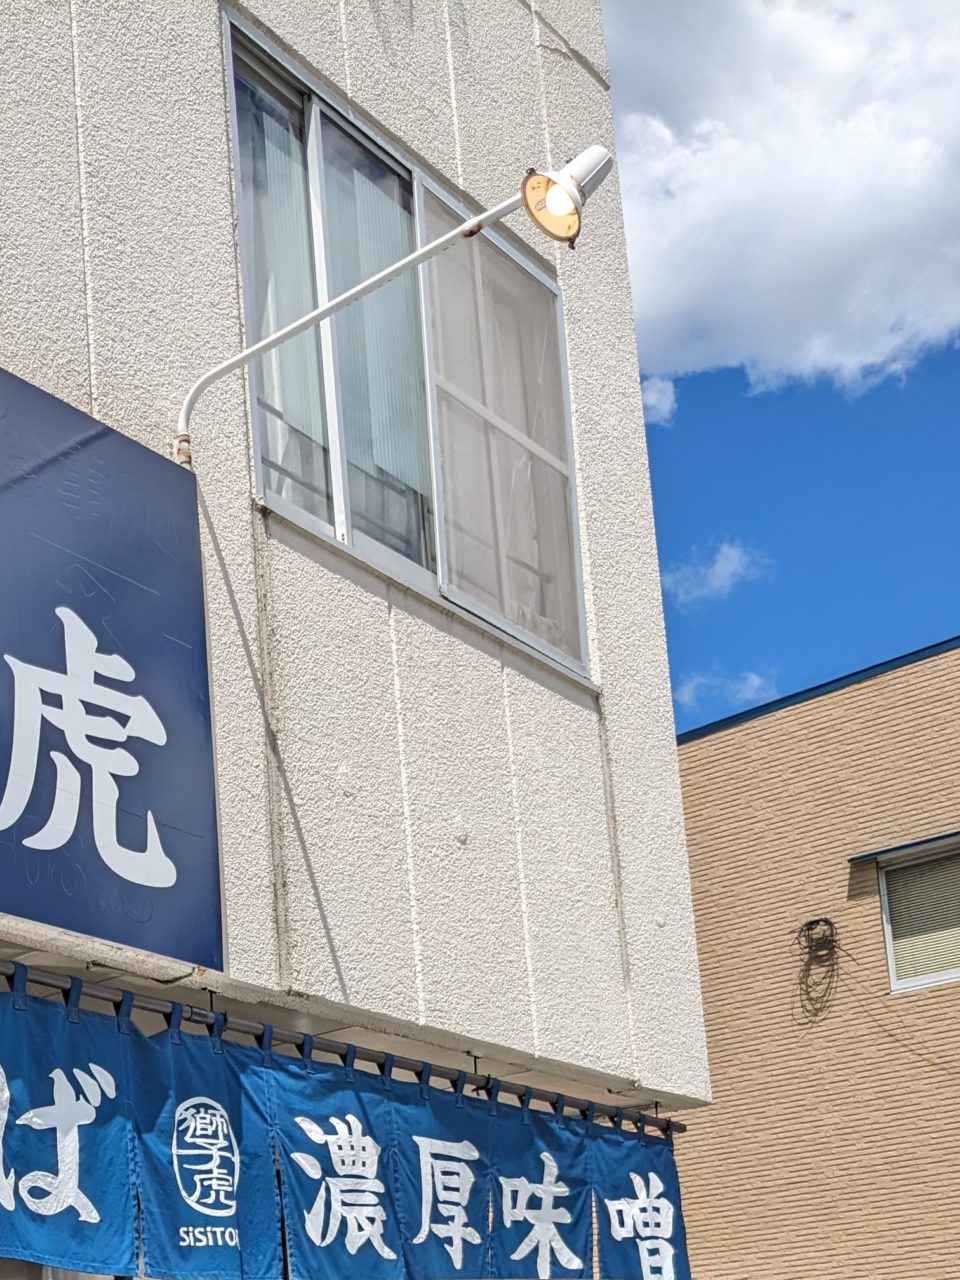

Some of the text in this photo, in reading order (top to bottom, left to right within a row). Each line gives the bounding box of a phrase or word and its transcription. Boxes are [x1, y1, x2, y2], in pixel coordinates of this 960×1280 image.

[174, 1105, 238, 1208] 獅子虎
[178, 1225, 239, 1249] SiSiTO
